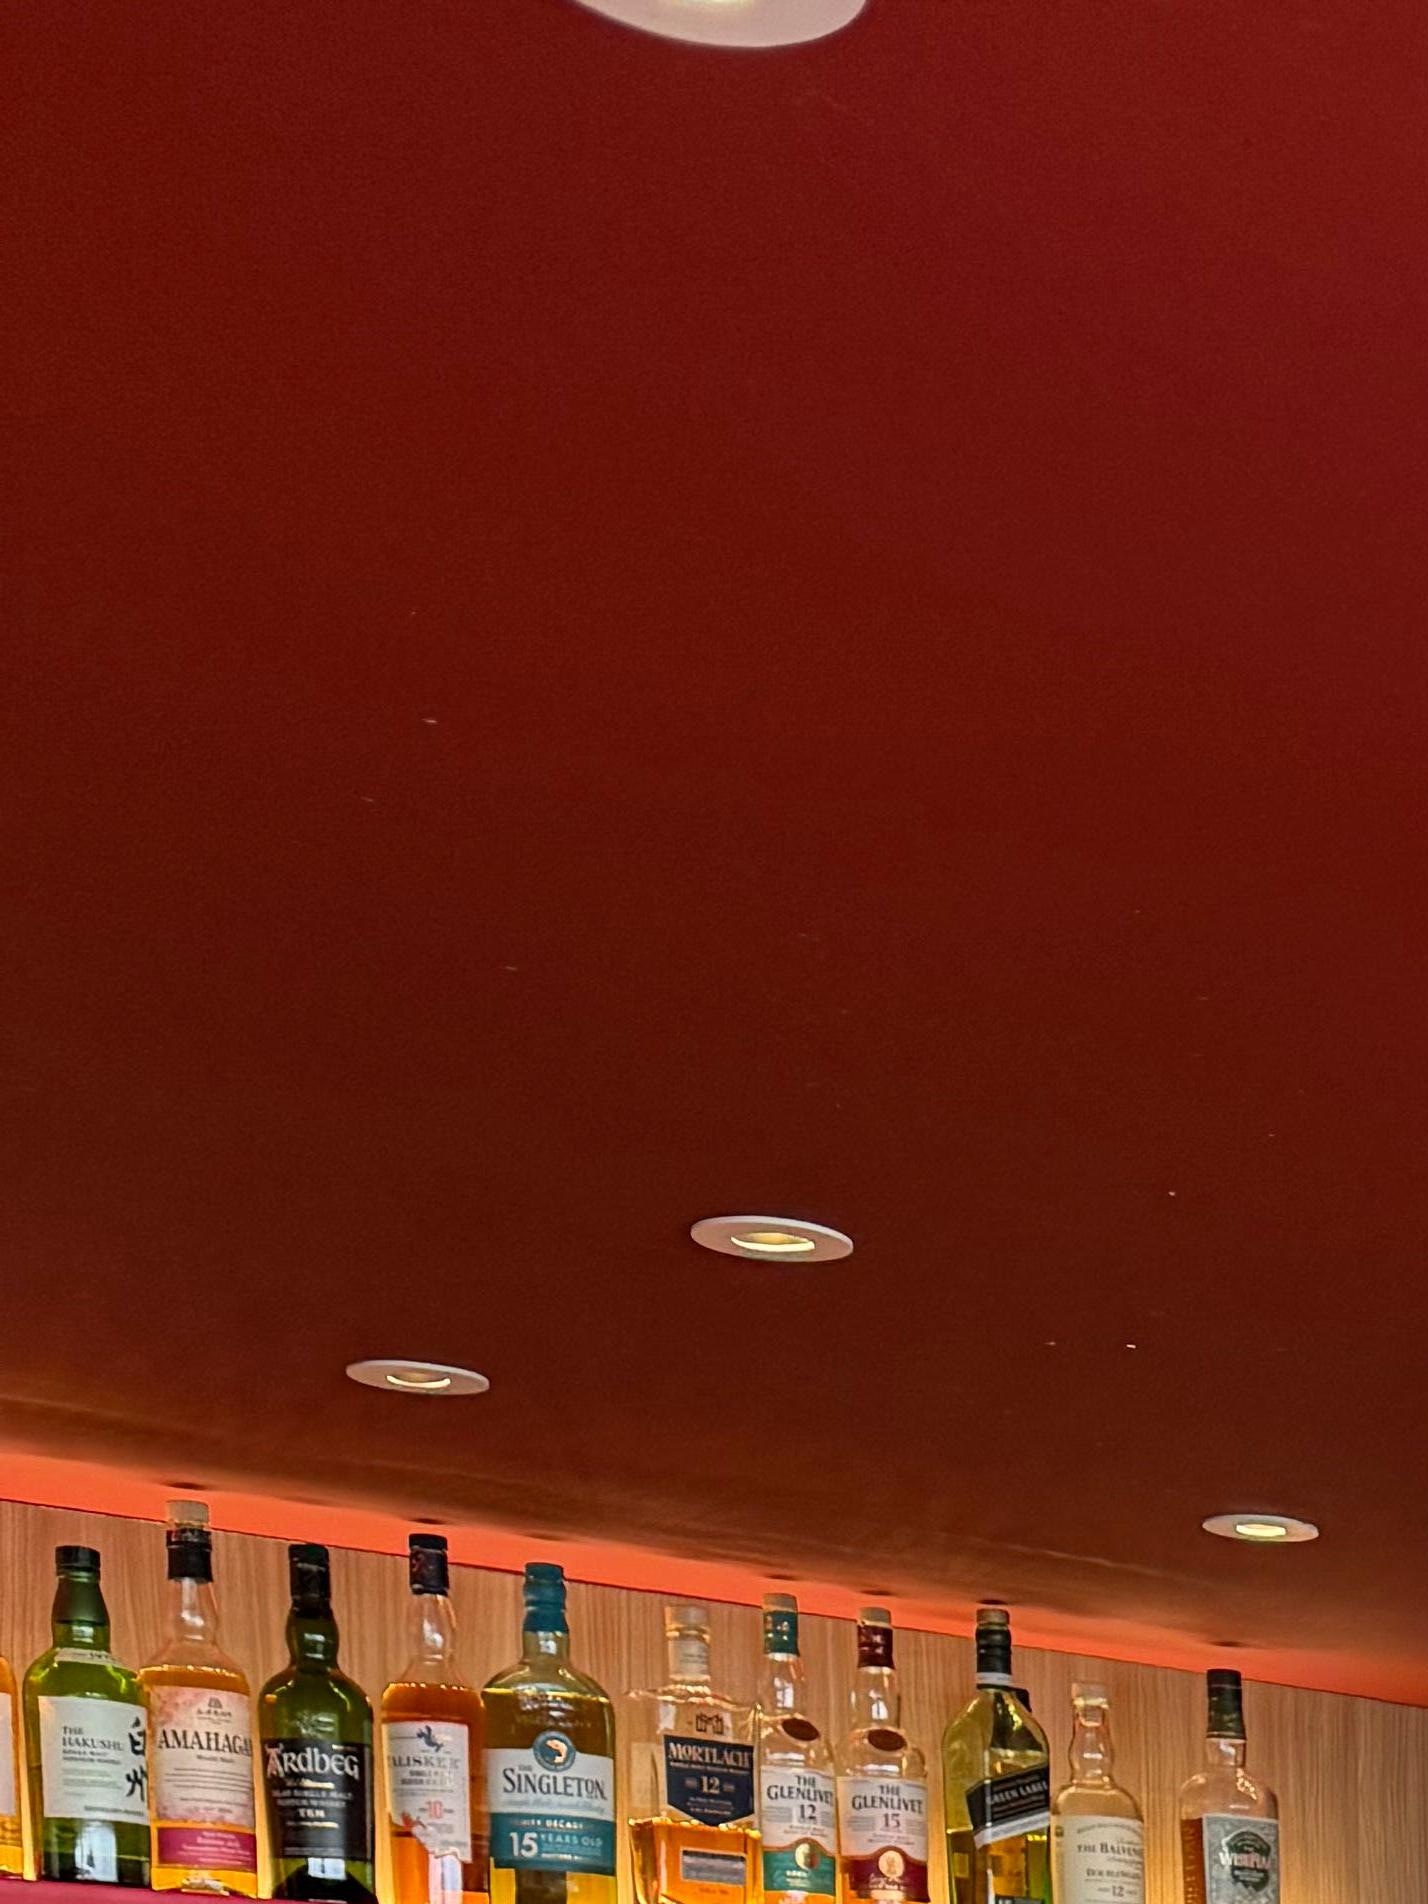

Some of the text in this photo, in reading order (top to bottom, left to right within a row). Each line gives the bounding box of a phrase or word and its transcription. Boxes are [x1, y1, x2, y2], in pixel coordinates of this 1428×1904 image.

[668, 1742, 750, 1766] MORTLACH
[503, 1767, 608, 1800] SINGLETON
[700, 1777, 721, 1795] 12
[796, 1775, 816, 1787] THE
[879, 1784, 901, 1796] THE
[799, 1804, 817, 1821] 12
[852, 1794, 923, 1815] GLENLIVET
[883, 1813, 901, 1829] 15
[509, 1832, 538, 1858] 15
